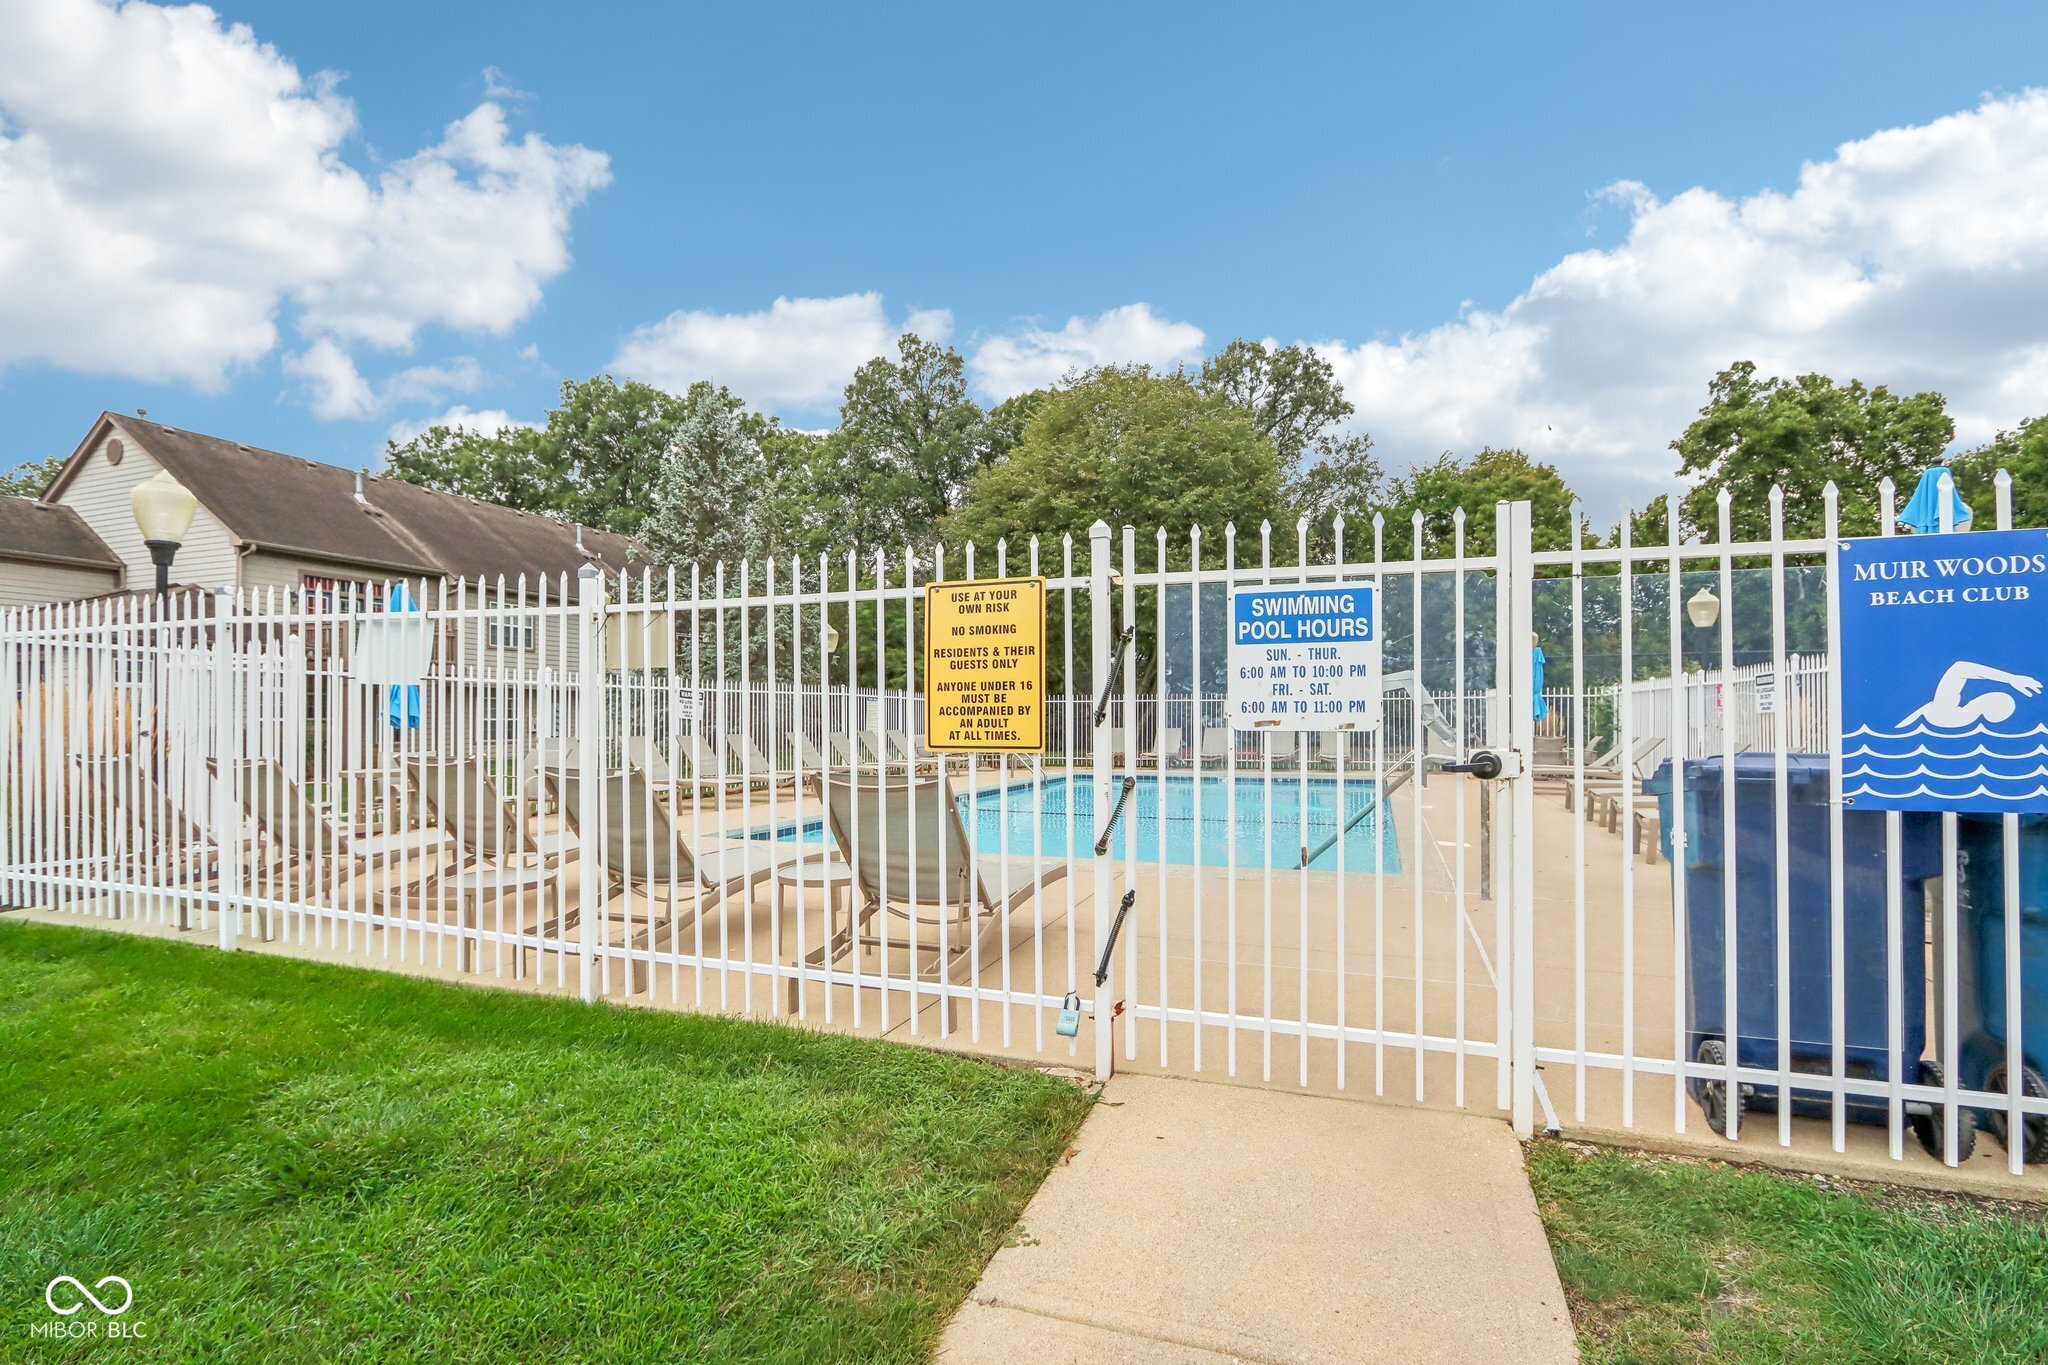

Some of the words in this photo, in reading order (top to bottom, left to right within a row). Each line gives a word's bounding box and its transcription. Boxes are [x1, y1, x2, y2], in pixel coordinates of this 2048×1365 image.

[1854, 560, 1930, 581] MUIR
[1934, 554, 2046, 577] WOODS
[952, 592, 970, 602] USE
[974, 592, 986, 601] AT
[990, 590, 1017, 600] YOUR
[1870, 589, 1954, 606] BEACH
[1962, 586, 2030, 602] CLUB
[959, 604, 981, 614] OWN
[986, 603, 1009, 613] RISK
[1252, 594, 1355, 617] SWIMMING
[952, 626, 965, 636] NO
[969, 624, 1016, 635] SMOKING
[1239, 621, 1291, 639] POOL
[1298, 617, 1368, 638] HOURS
[934, 647, 989, 658] RESIDENTS
[993, 647, 1000, 656] &
[1005, 646, 1035, 656] THEIR
[1267, 649, 1291, 661] SUN.
[1308, 648, 1341, 660] THUR.
[950, 660, 988, 670] GUESTS
[993, 659, 1018, 669] ONLY
[1240, 667, 1263, 678] 6:00
[1270, 666, 1286, 678] AM
[1293, 666, 1306, 678] TO
[1313, 665, 1343, 677] 10:00
[1350, 665, 1366, 677] PM
[937, 682, 976, 691] ANYONE
[981, 681, 1015, 691] UNDER
[1020, 681, 1032, 690] 16
[1273, 684, 1292, 696] FRI.
[1310, 683, 1331, 695] SAT.
[962, 694, 989, 703] MUST
[994, 694, 1006, 703] BE
[939, 706, 1014, 716] ACCOMPANIED
[1018, 706, 1031, 715] BY
[1241, 701, 1265, 713] 6:00
[1272, 701, 1287, 713] AM
[1294, 701, 1307, 713] TO
[1314, 701, 1342, 713] 11:00
[1349, 701, 1365, 713] PM
[960, 719, 973, 728] AN
[977, 718, 1009, 728] ADULT
[949, 731, 962, 740] AT
[964, 731, 981, 740] ALL
[984, 731, 1020, 740] TIMES.
